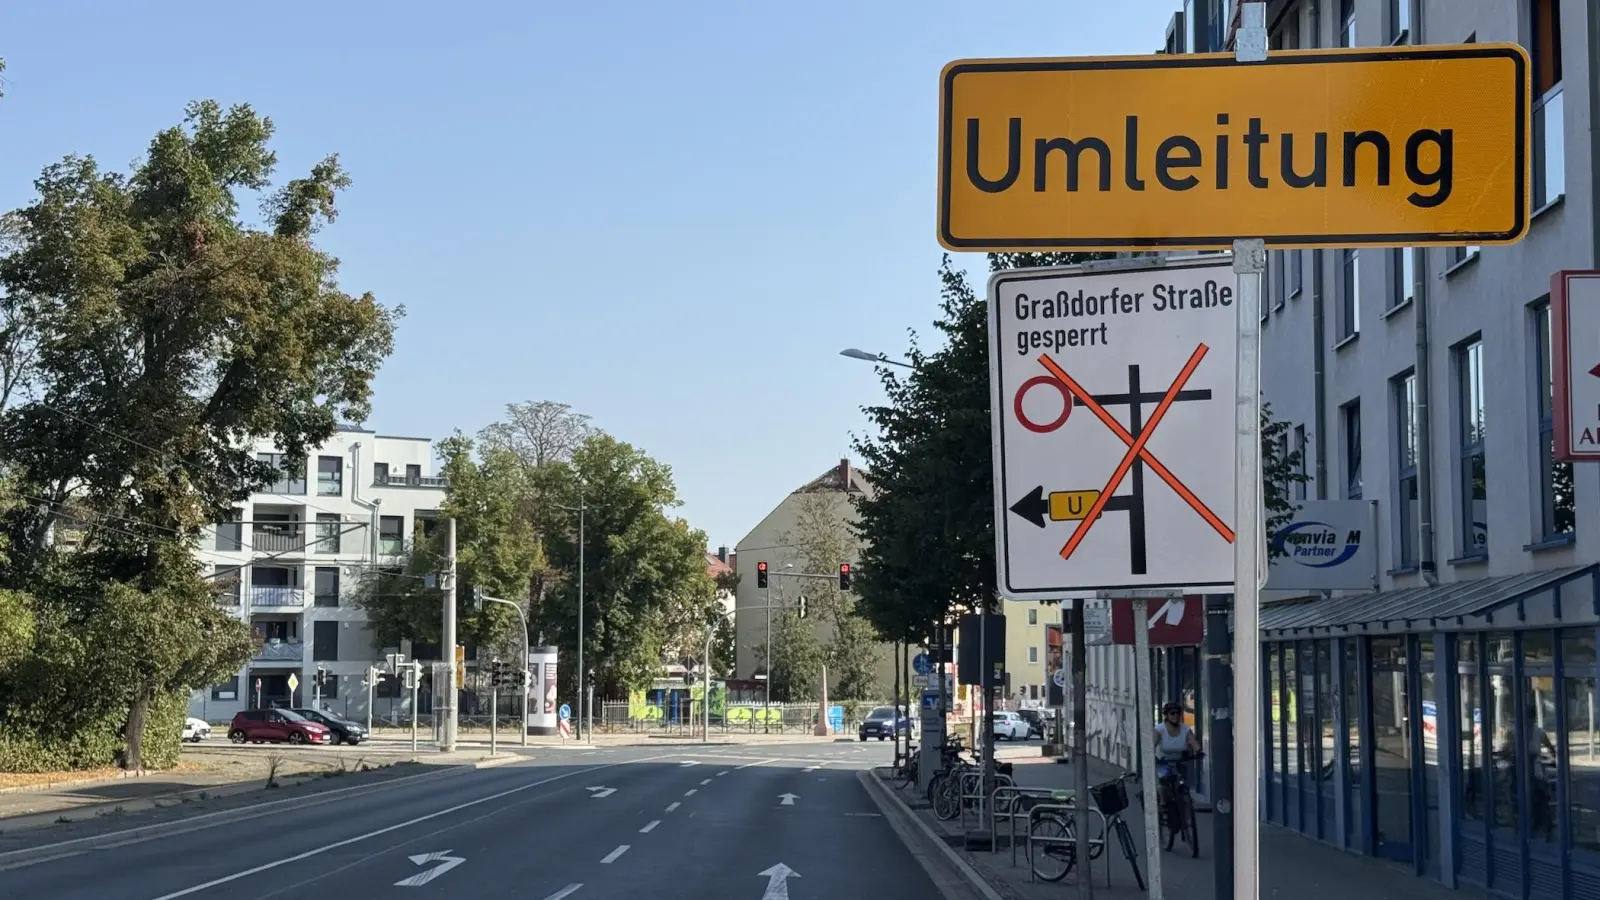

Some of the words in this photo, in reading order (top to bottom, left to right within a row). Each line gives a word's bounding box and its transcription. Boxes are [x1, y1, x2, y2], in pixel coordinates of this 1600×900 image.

[966, 113, 1454, 208] Umleitung
[1015, 287, 1145, 320] Graßdorfer
[1152, 280, 1233, 311] Straße
[1017, 322, 1108, 356] gesperrt
[1068, 496, 1082, 515] U
[1294, 546, 1336, 556] Partner
